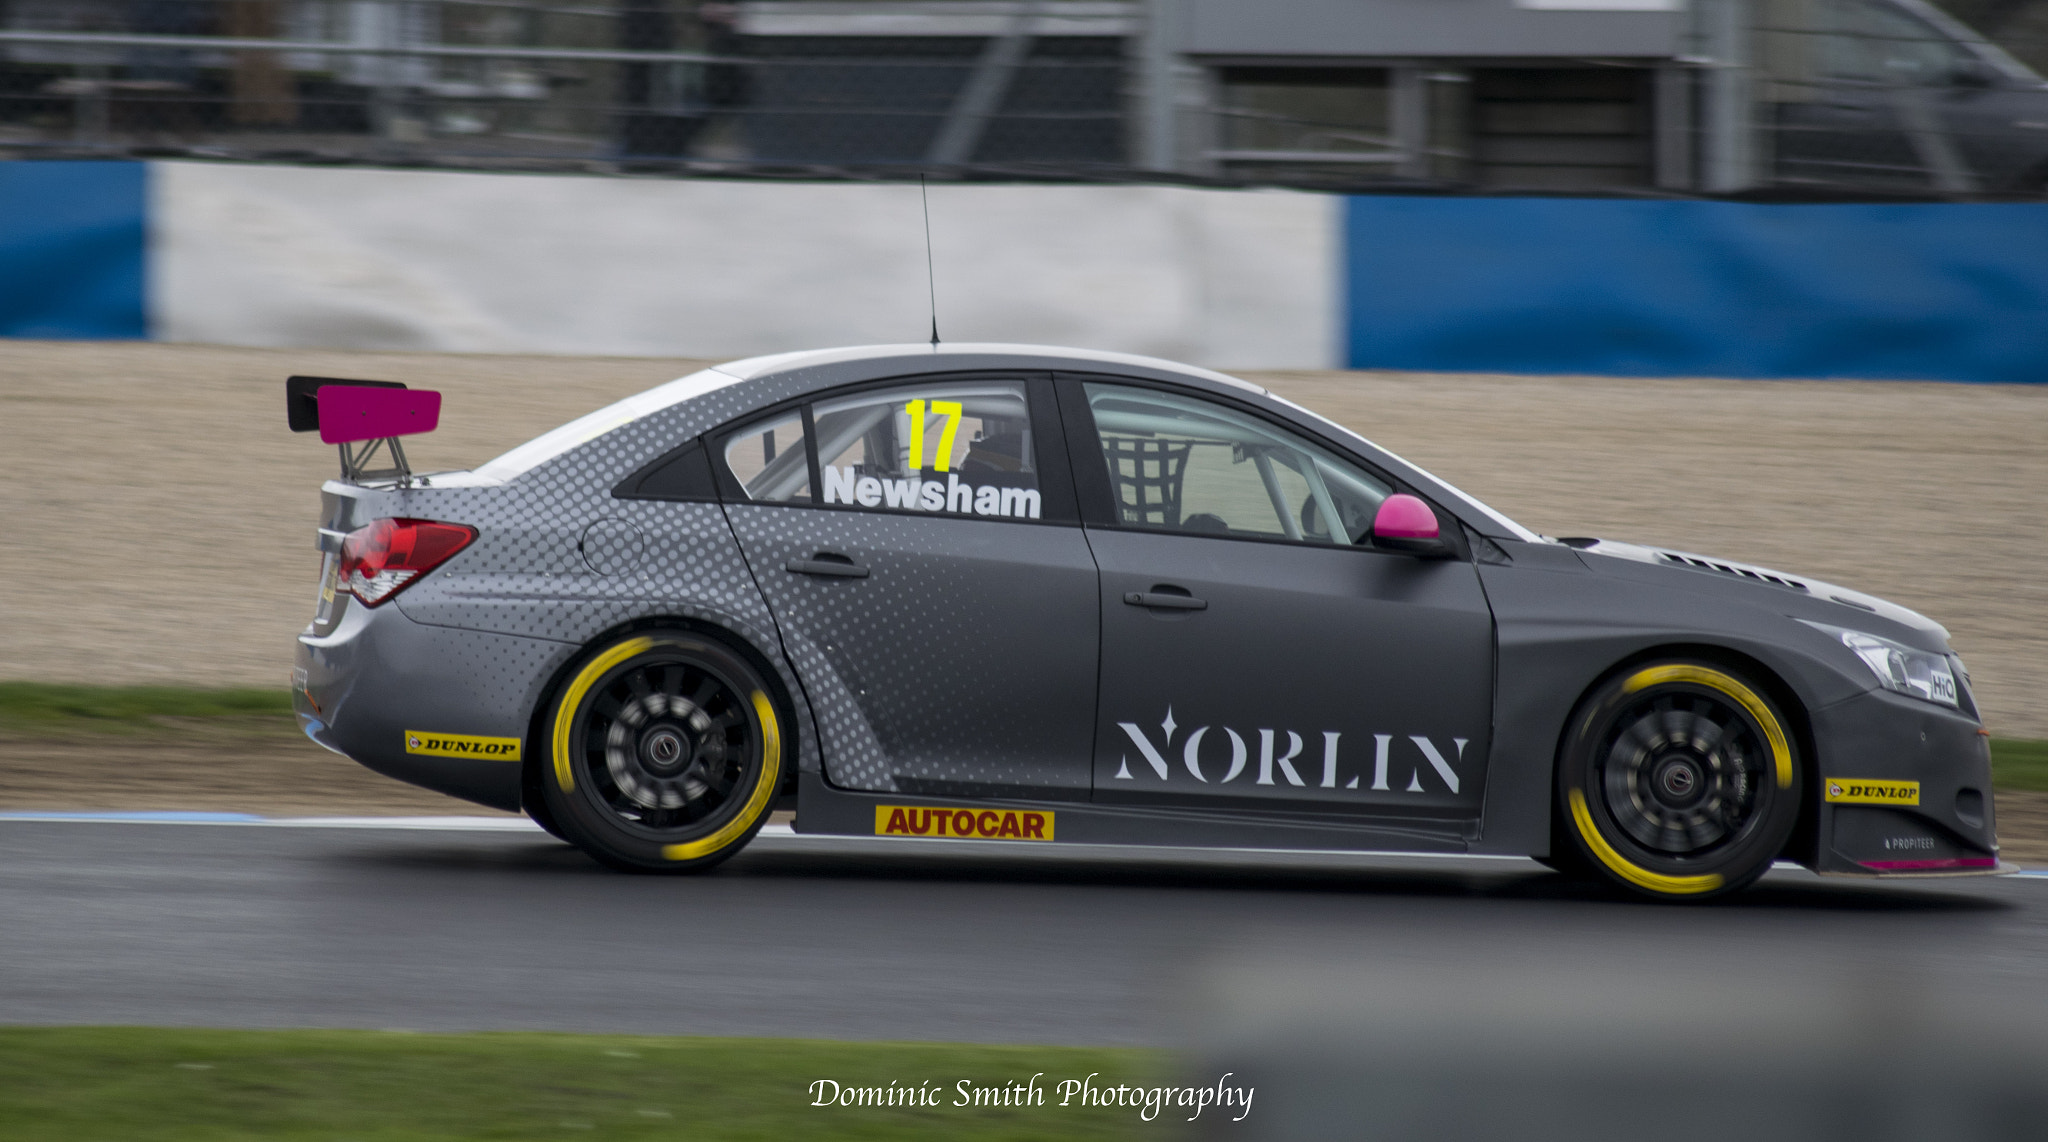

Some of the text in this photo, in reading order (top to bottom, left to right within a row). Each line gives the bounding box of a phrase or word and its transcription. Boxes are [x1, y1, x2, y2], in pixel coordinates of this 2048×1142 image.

[905, 399, 962, 473] 17
[823, 465, 1042, 519] Newsham
[1933, 675, 1955, 699] HiQ
[424, 738, 516, 755] DUNLOP
[1114, 702, 1469, 794] NORLIN
[1847, 785, 1917, 799] DUNLOP
[885, 808, 1045, 839] AUTOCAR
[1893, 837, 1935, 850] PROPITEER
